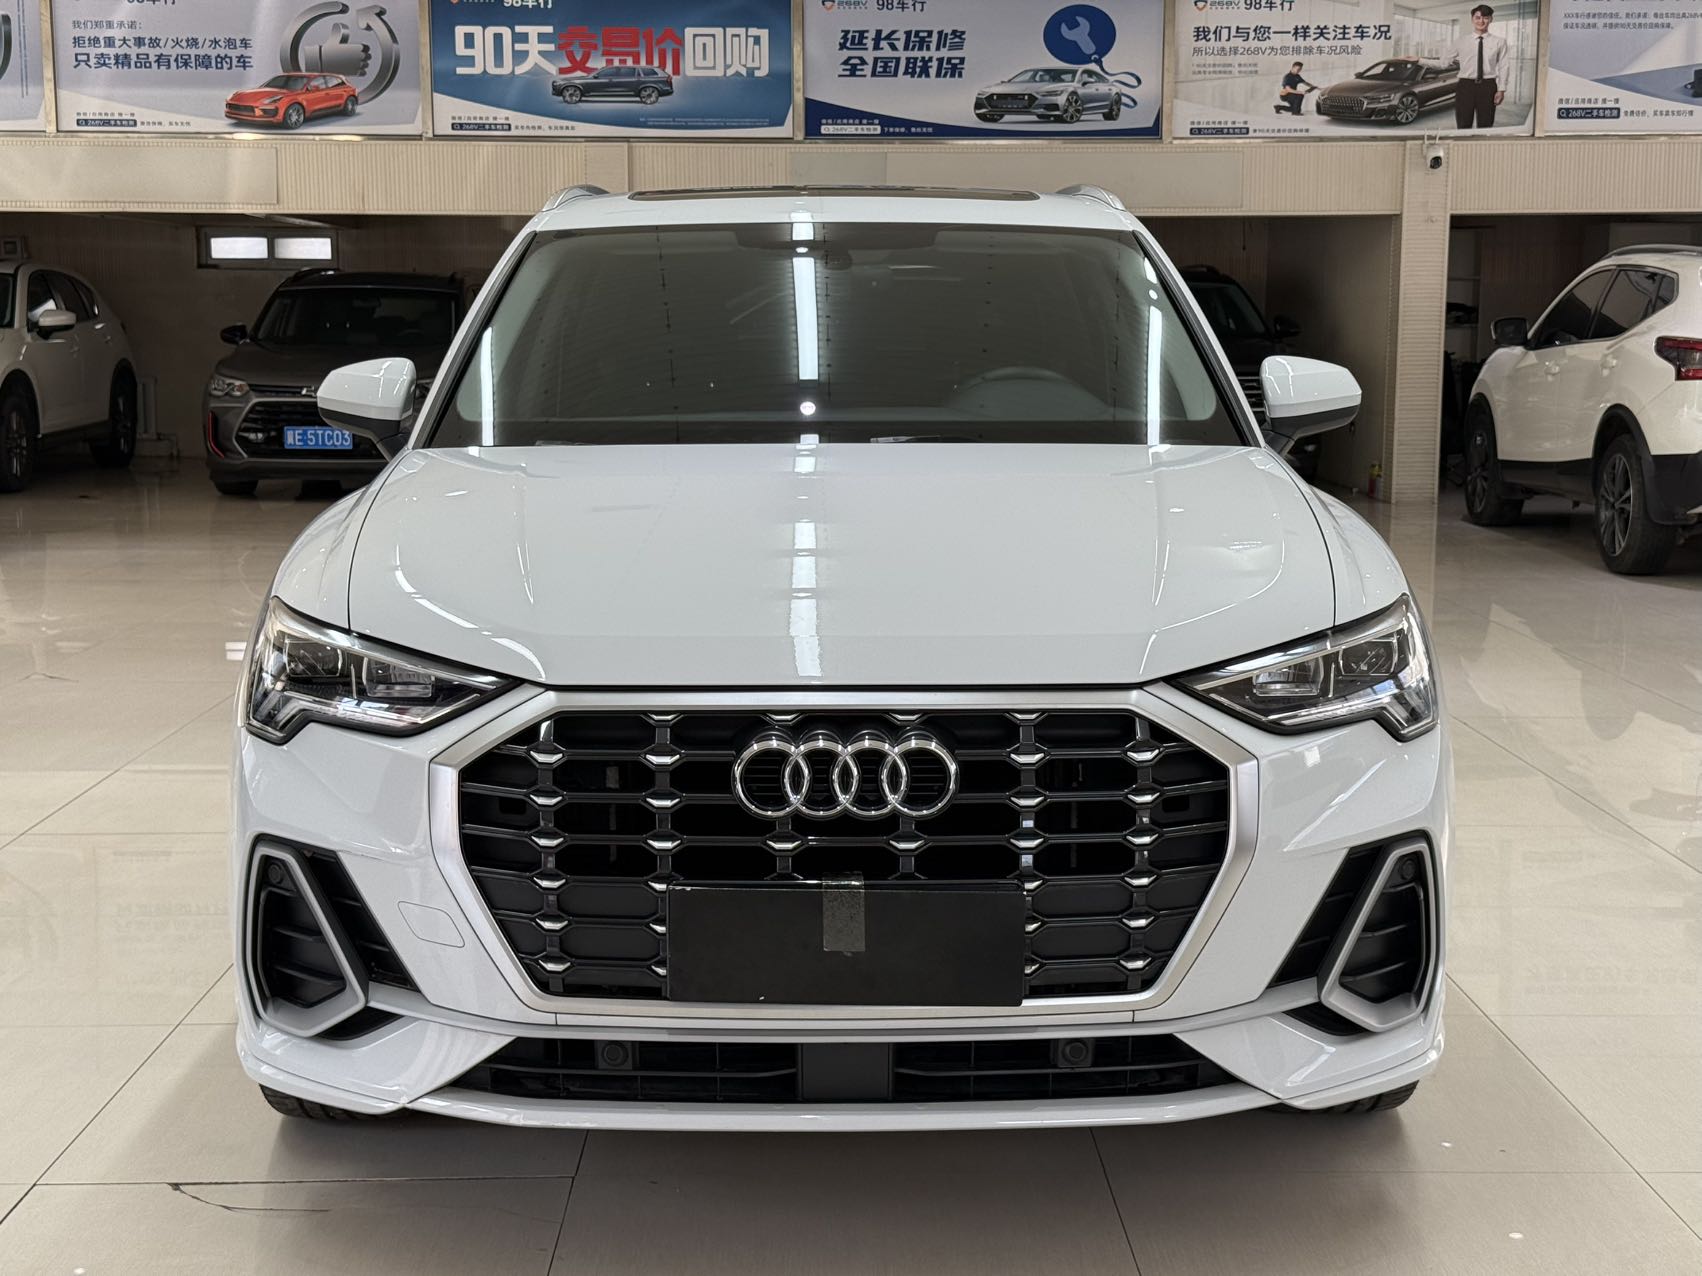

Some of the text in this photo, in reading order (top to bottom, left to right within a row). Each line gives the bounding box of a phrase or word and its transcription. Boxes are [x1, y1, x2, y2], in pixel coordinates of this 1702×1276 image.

[876, 0, 927, 12] 98车行
[1244, 0, 1295, 12] 98车行
[72, 35, 253, 50] 拒绝重大事故/火烧/水泡车
[838, 29, 967, 51] 延长保修
[1192, 24, 1392, 43] 我们与您一样关注车况
[454, 25, 770, 77] 90天交易价回购
[1191, 45, 1363, 57] 所以选择268V为您排除车况风险
[73, 52, 254, 71] 只卖精品有保障的车
[837, 56, 966, 79] 全国联保
